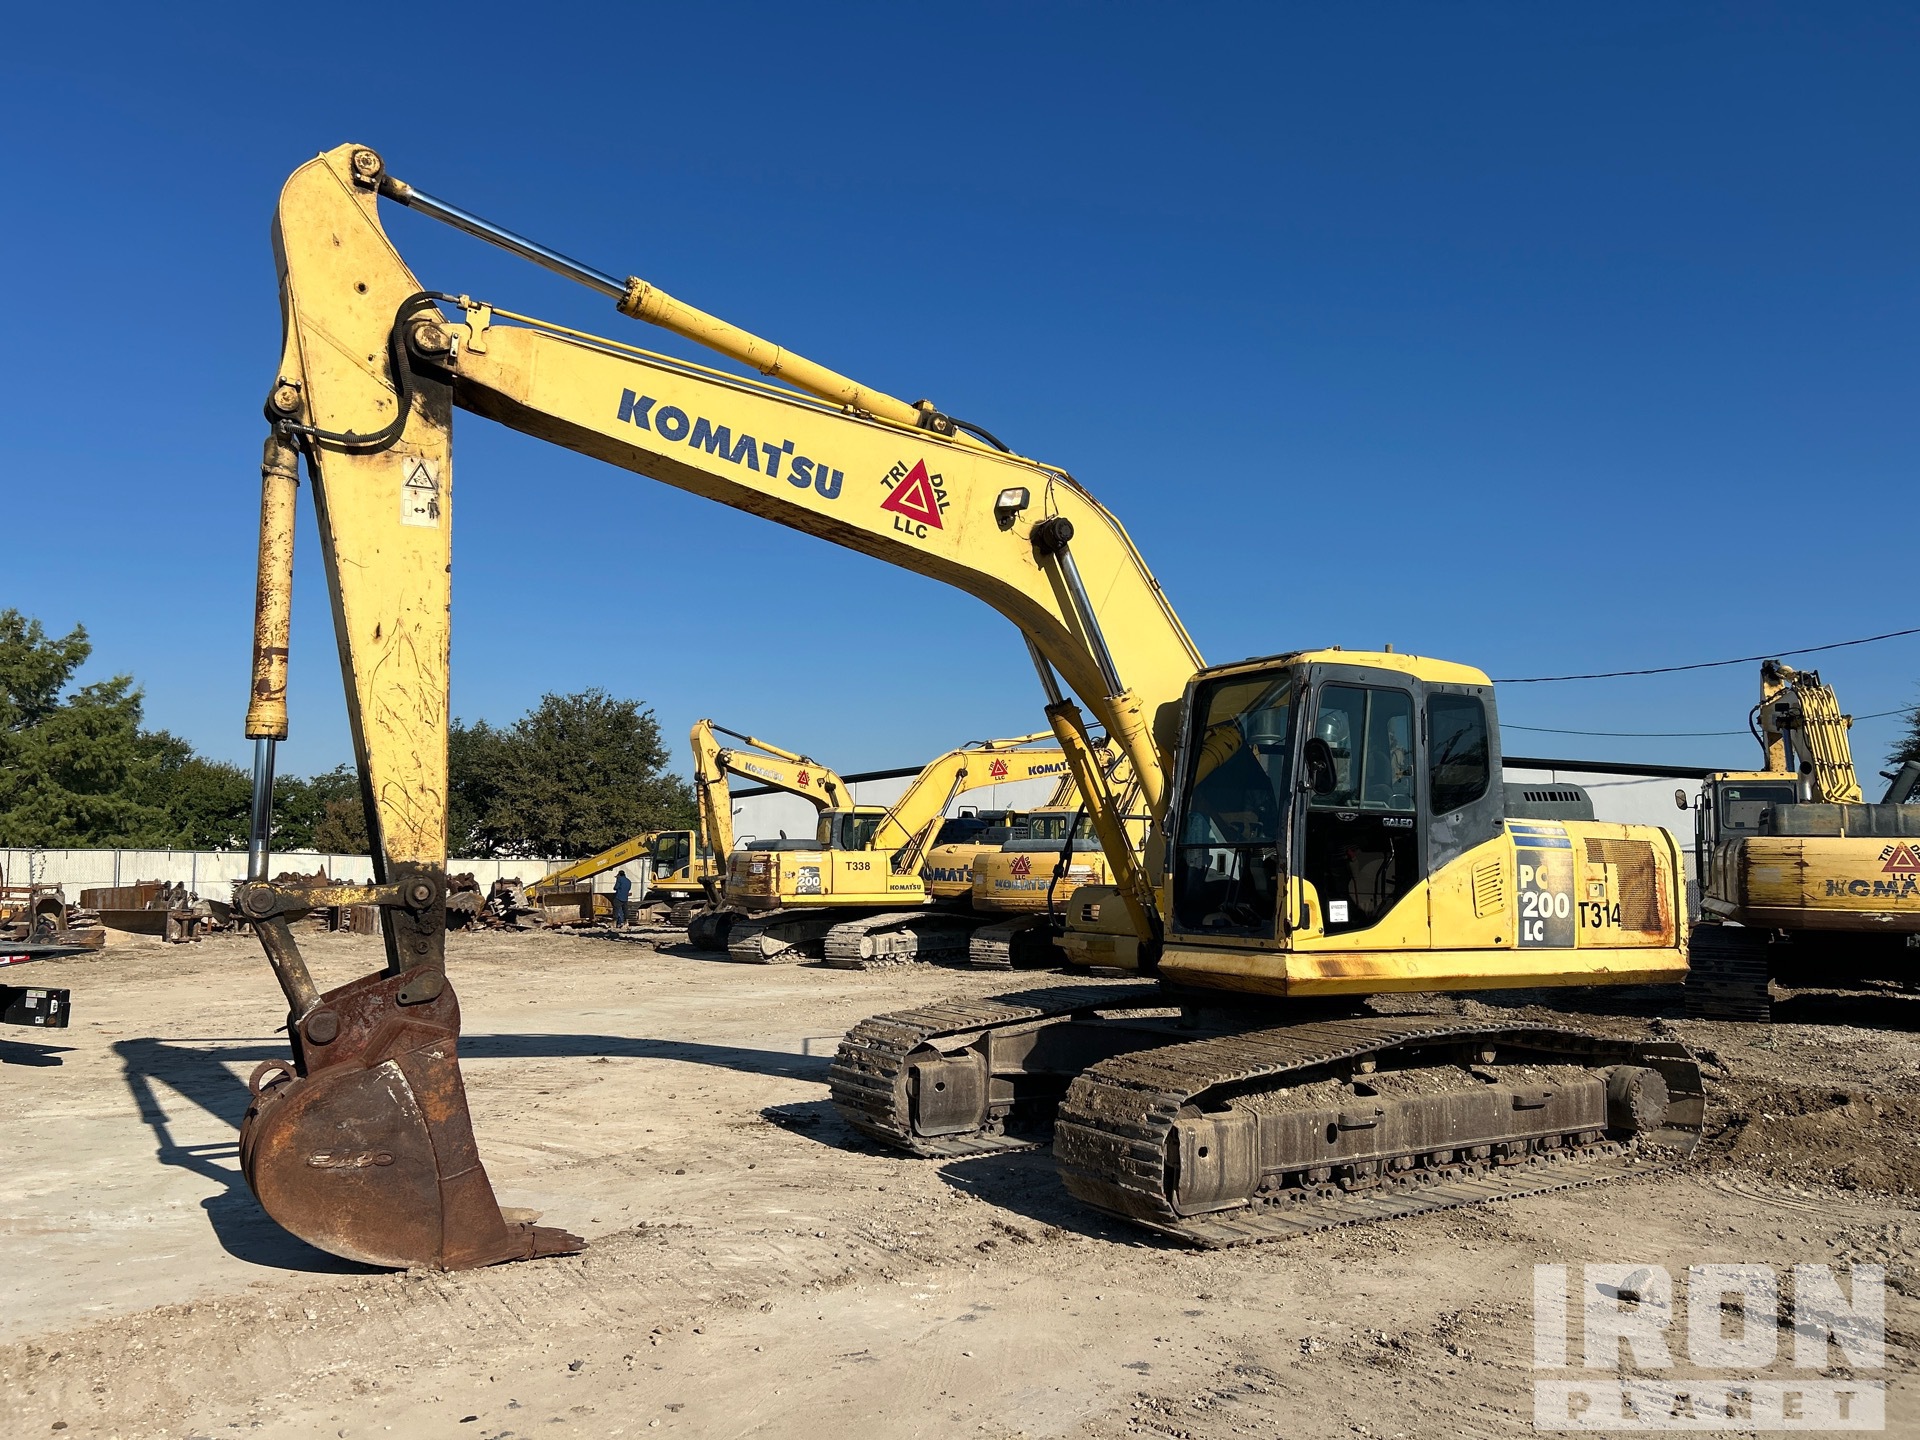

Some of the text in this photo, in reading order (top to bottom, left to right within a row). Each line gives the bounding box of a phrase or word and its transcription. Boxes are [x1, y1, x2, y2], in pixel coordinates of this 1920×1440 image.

[616, 388, 844, 500] KOMATSU
[880, 460, 951, 515] TRI DAL
[893, 515, 928, 540] LLC
[1028, 759, 1071, 776] KOMAT
[1382, 817, 1413, 828] GALEO
[1877, 844, 1895, 862] TRI
[846, 861, 871, 871] T338
[1010, 856, 1033, 869] TRI DAL
[798, 876, 820, 886] 200
[799, 868, 810, 877] PC
[1519, 864, 1549, 890] PC
[1892, 873, 1917, 881] LLC
[889, 882, 922, 891] KOMATSU
[1522, 891, 1570, 919] 200
[1578, 902, 1621, 928] T314
[1523, 920, 1544, 941] LC
